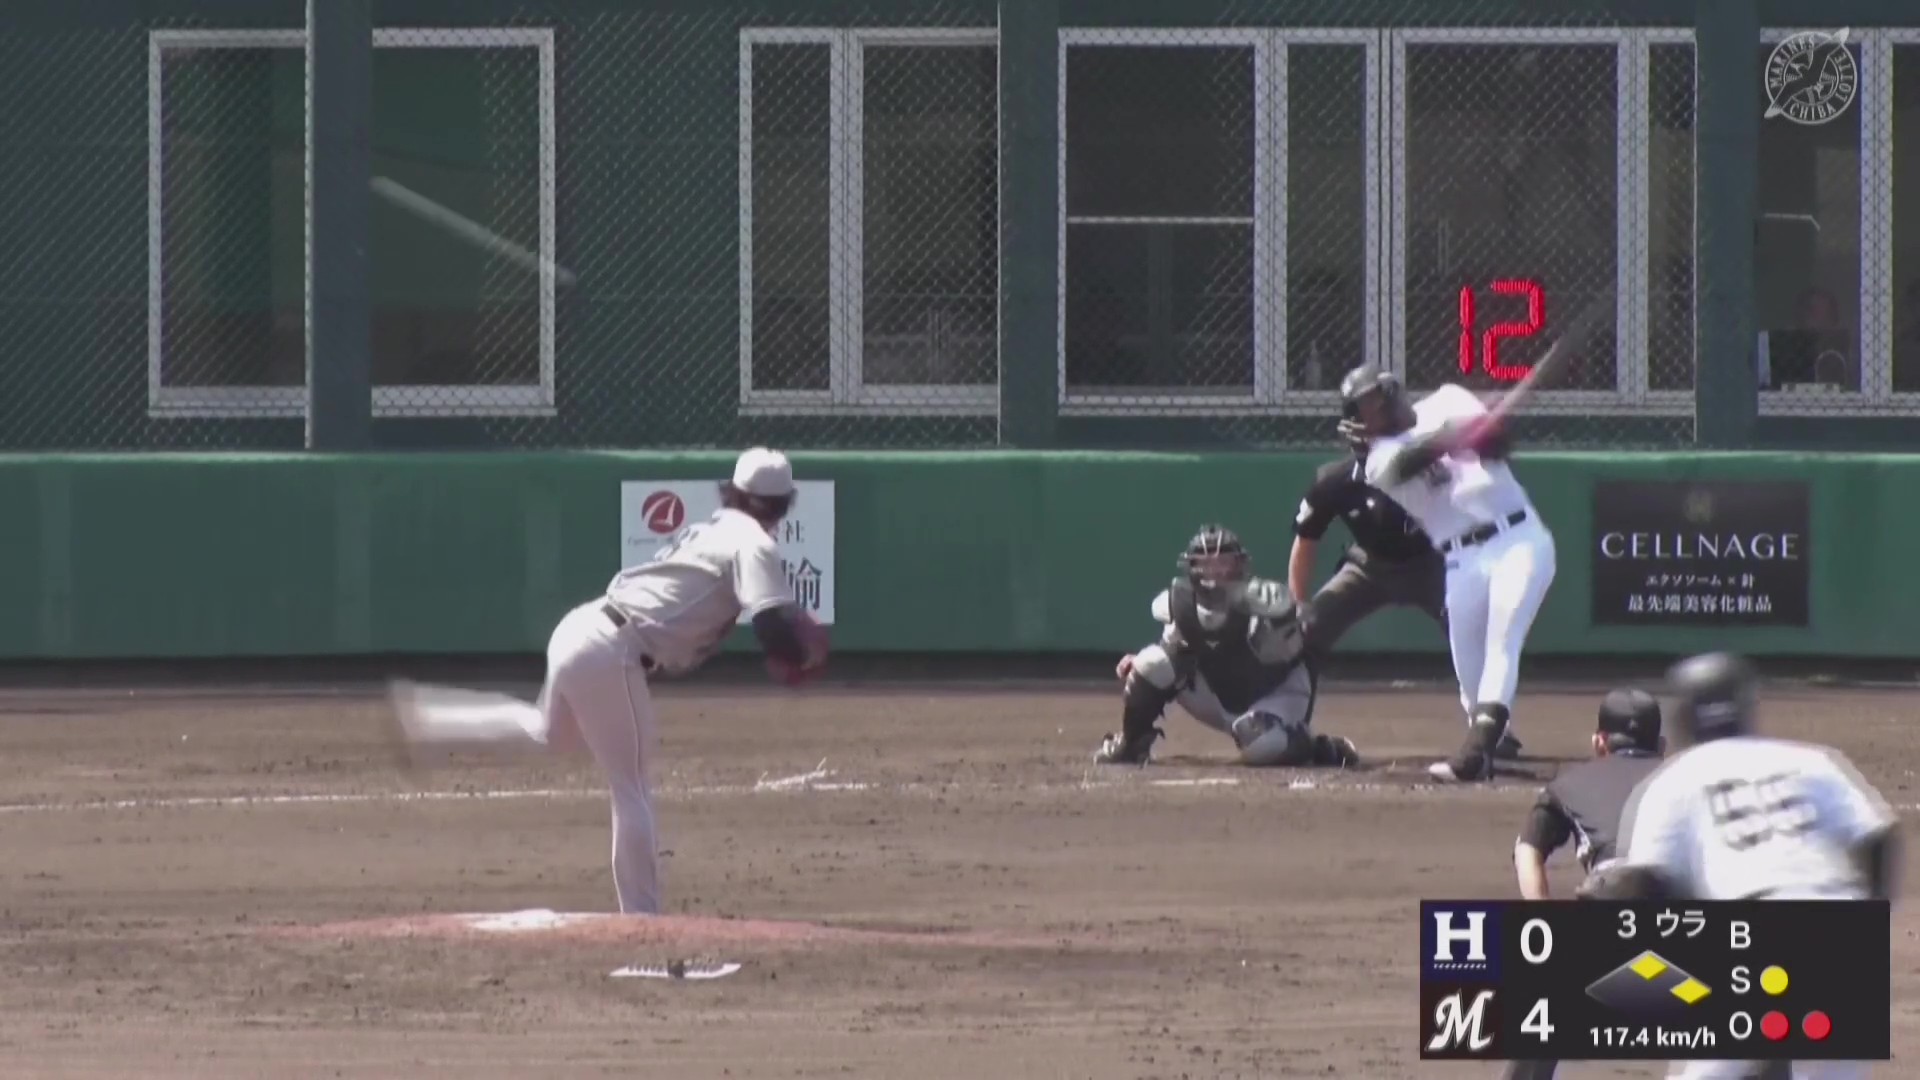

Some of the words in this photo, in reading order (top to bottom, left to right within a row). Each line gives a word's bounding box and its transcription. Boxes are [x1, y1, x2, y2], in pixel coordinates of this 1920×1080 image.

[1459, 277, 1544, 380] 12
[1601, 532, 1799, 560] CELLNAGE
[1628, 594, 1772, 613] 最先端美容化粧品
